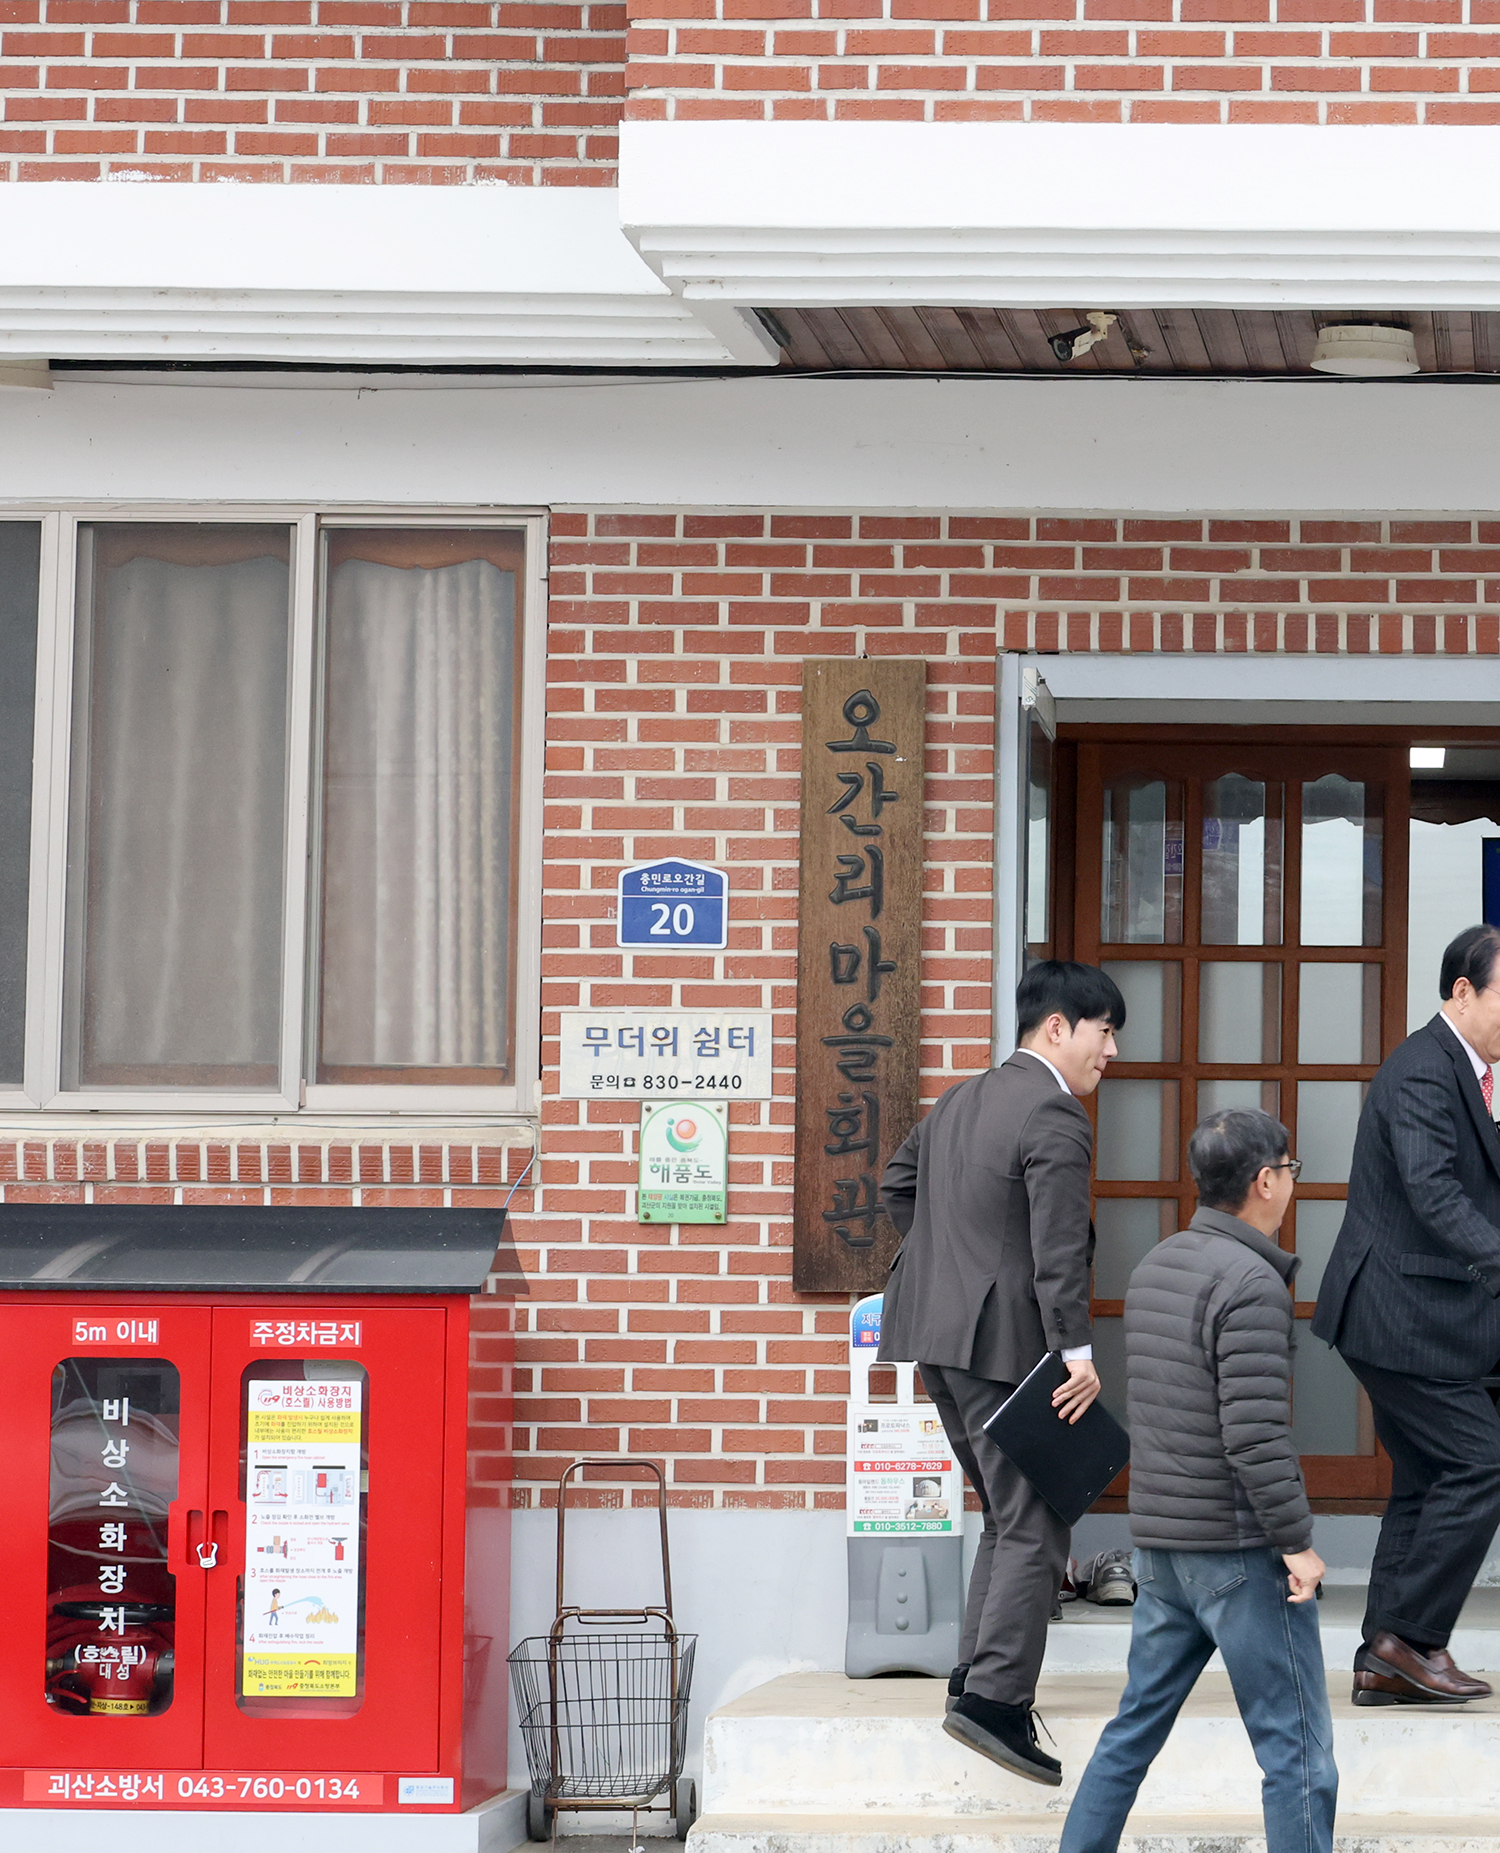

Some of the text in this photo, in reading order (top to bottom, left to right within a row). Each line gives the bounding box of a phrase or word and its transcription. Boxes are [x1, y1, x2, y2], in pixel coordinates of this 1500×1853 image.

[640, 873, 705, 885] 충민로오간길
[650, 903, 694, 935] 20
[820, 689, 899, 1249] 오간리마을회관
[582, 1026, 755, 1057] 무더위 쉼터
[590, 1074, 742, 1090] 문의 830-2440
[649, 1164, 712, 1183] 해품도
[75, 1320, 158, 1343] 5m 이내
[252, 1321, 361, 1346] 주정차금지
[318, 1398, 352, 1408] 사용방법
[874, 1462, 943, 1471] 010-6278-7629
[97, 1396, 129, 1636] 비상소화장치
[252, 1514, 257, 1524] 2
[874, 1522, 943, 1531] 010-3512-7880
[251, 1568, 256, 1578] 3
[249, 1633, 255, 1643] 4
[74, 1644, 147, 1665] (호스릴)
[48, 1775, 360, 1801] 괴산소방서 043-760-0134
